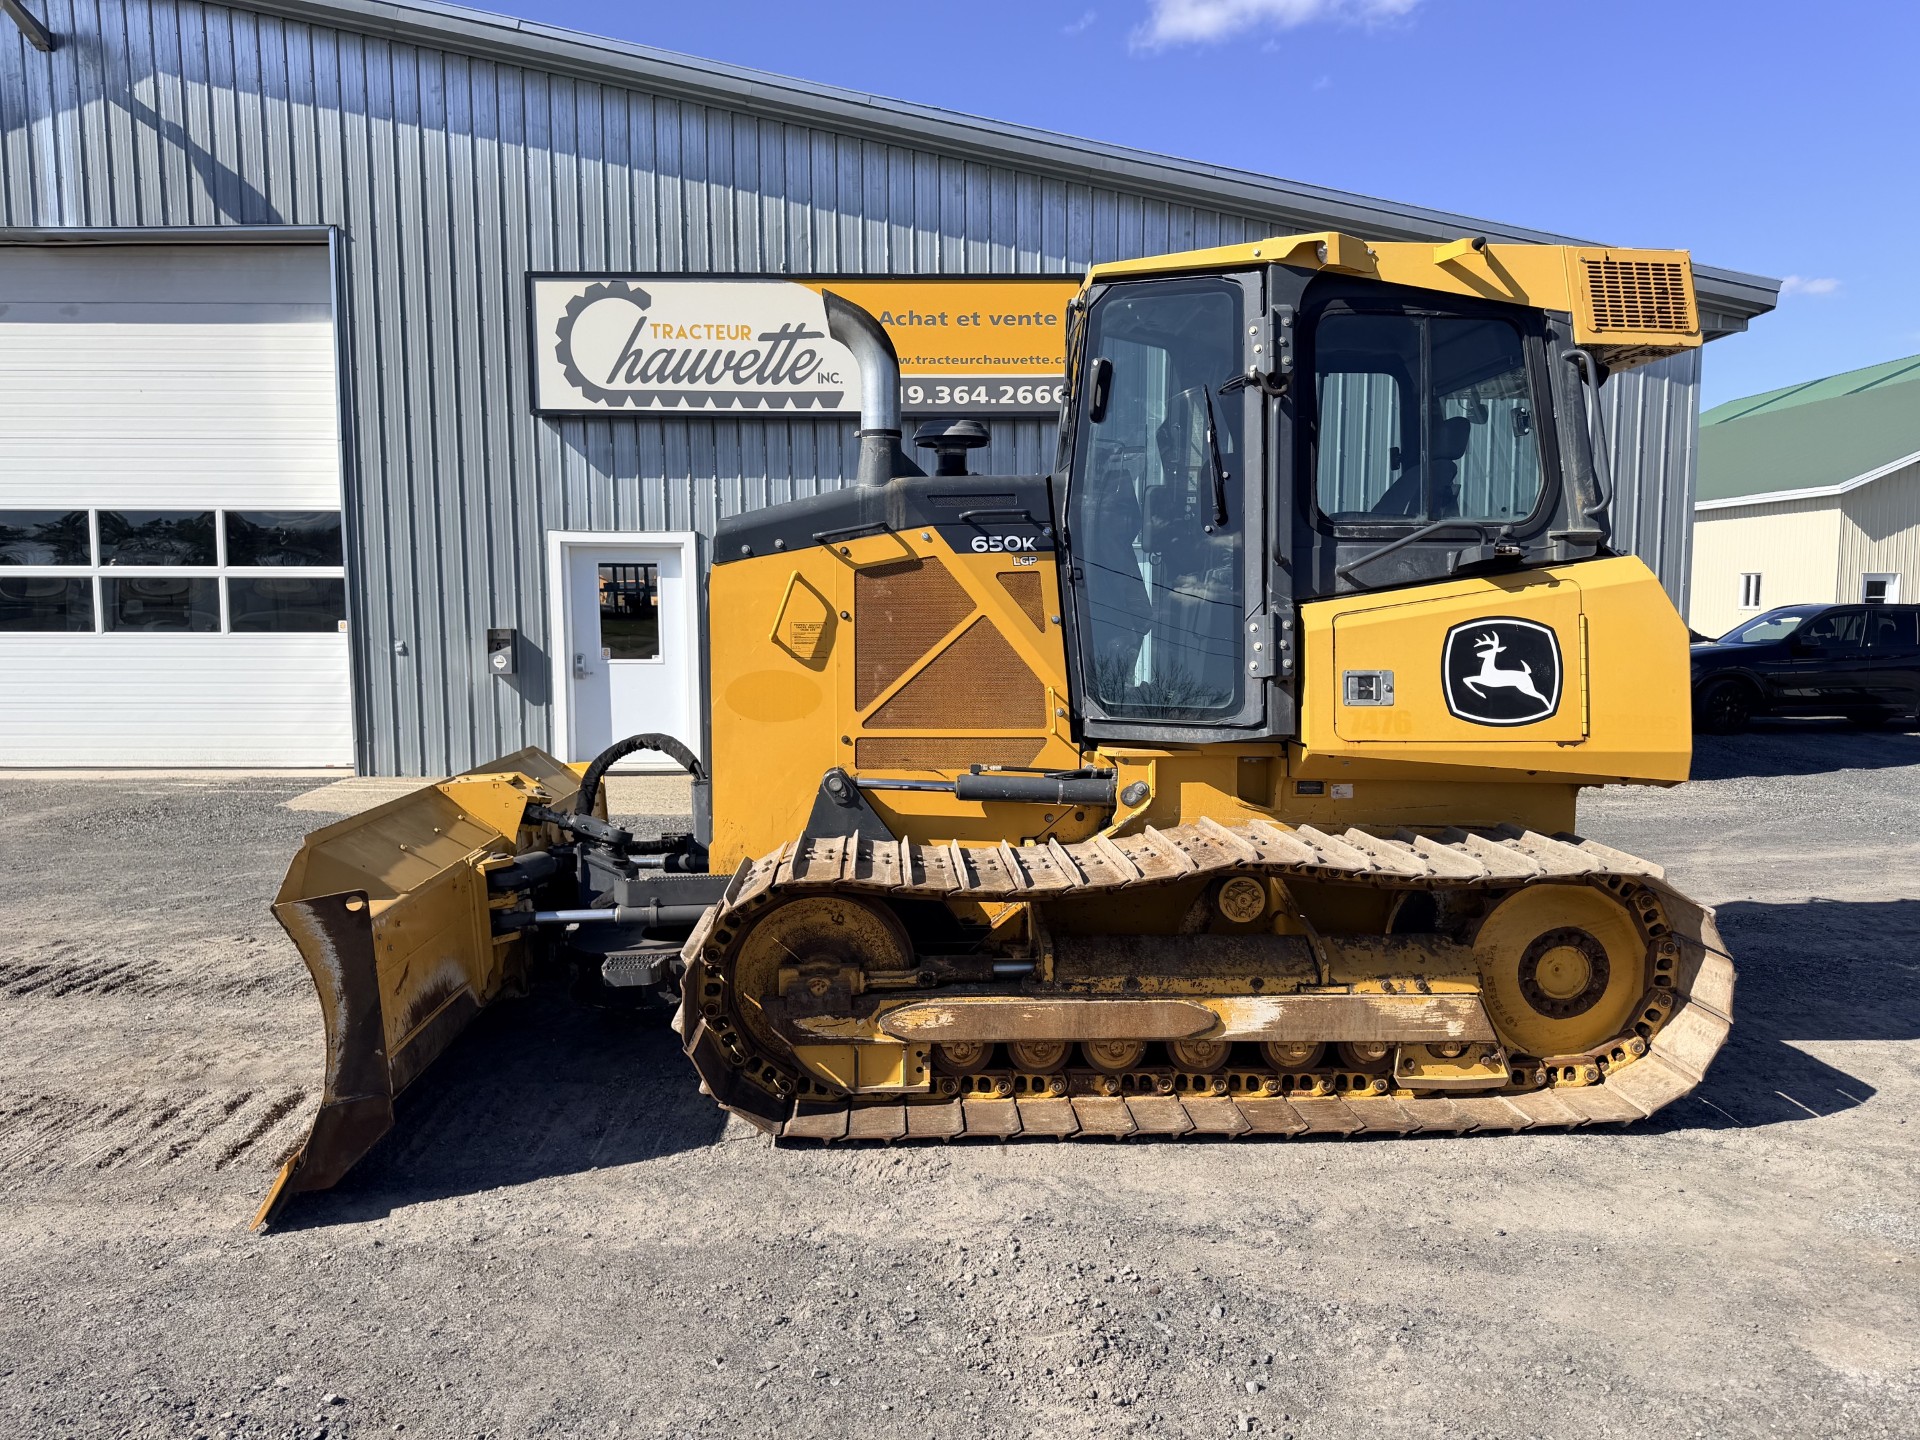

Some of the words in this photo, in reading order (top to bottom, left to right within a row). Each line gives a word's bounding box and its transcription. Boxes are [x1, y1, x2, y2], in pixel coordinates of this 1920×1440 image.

[879, 310, 949, 326] Achat
[956, 311, 981, 326] et
[989, 311, 1058, 326] vente
[650, 323, 752, 341] TRACTEUR
[555, 280, 844, 408] Chauvette
[817, 372, 844, 385] INC.
[971, 535, 1038, 553] 650K
[1012, 555, 1038, 567] LGP
